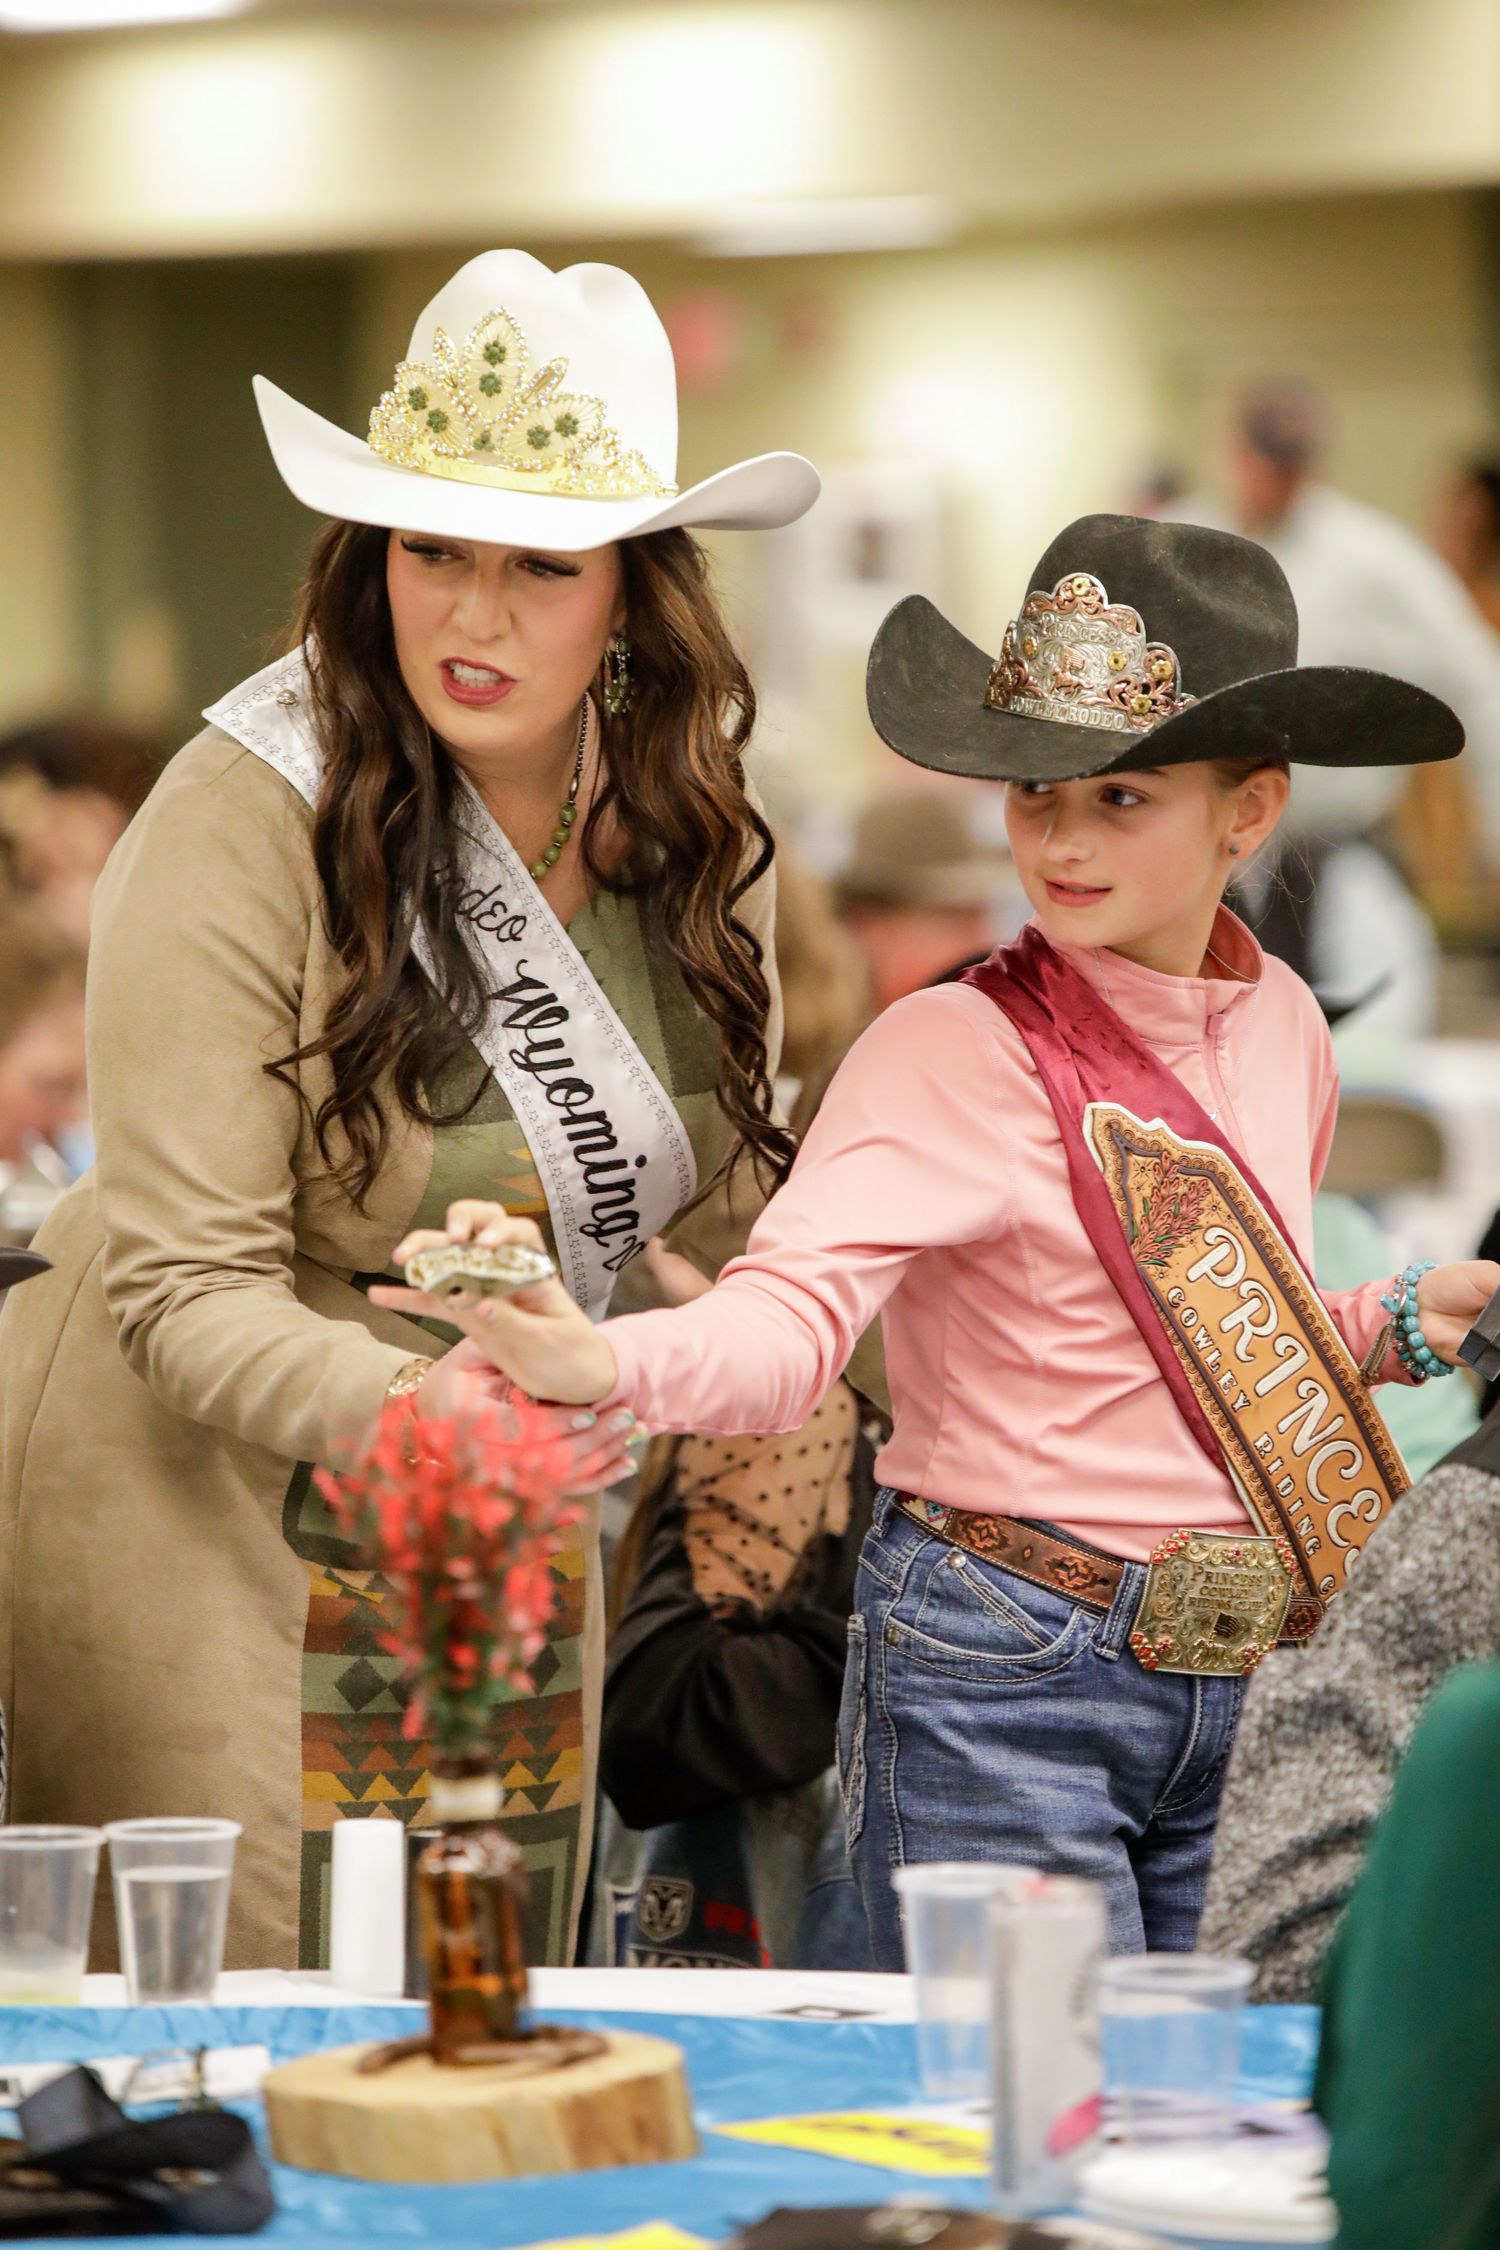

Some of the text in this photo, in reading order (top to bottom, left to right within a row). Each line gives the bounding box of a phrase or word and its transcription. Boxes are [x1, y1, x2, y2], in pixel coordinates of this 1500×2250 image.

[1040, 613, 1119, 645] PRINCESS
[1066, 706, 1126, 730] RODEO
[487, 959, 648, 1249] Wyoming
[1168, 1286, 1250, 1413] COWLEY
[1255, 1432, 1321, 1558] RIDING
[1190, 1564, 1263, 1587] PRINCESS
